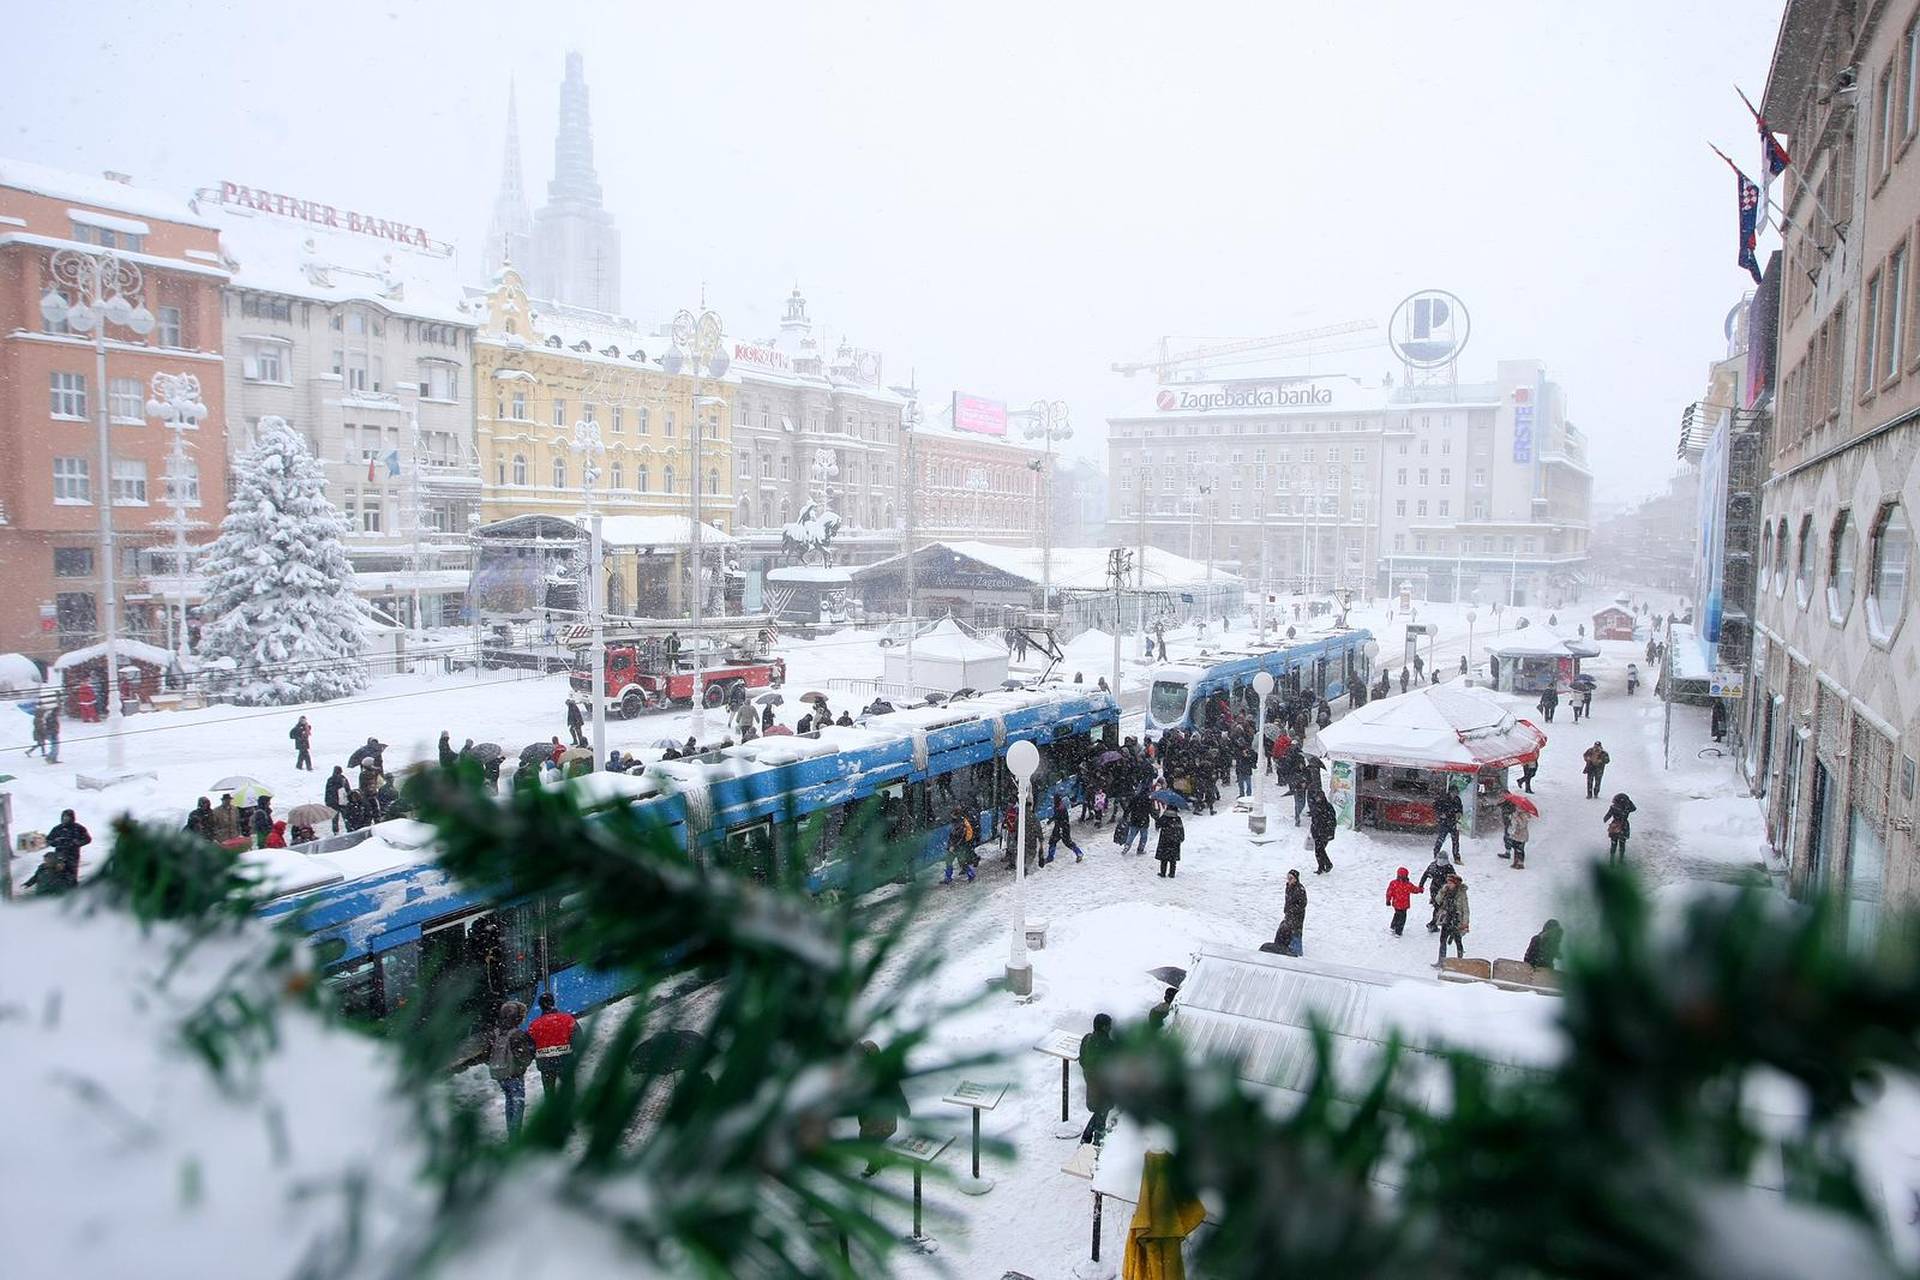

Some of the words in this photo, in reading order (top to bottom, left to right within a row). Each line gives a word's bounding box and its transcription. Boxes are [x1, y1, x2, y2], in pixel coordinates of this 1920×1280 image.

[221, 181, 338, 228] PARTNER
[346, 211, 431, 249] BANKA
[1180, 387, 1273, 411] Zagrebačka
[1278, 384, 1332, 405] banka
[1513, 406, 1534, 464] ERSTE
